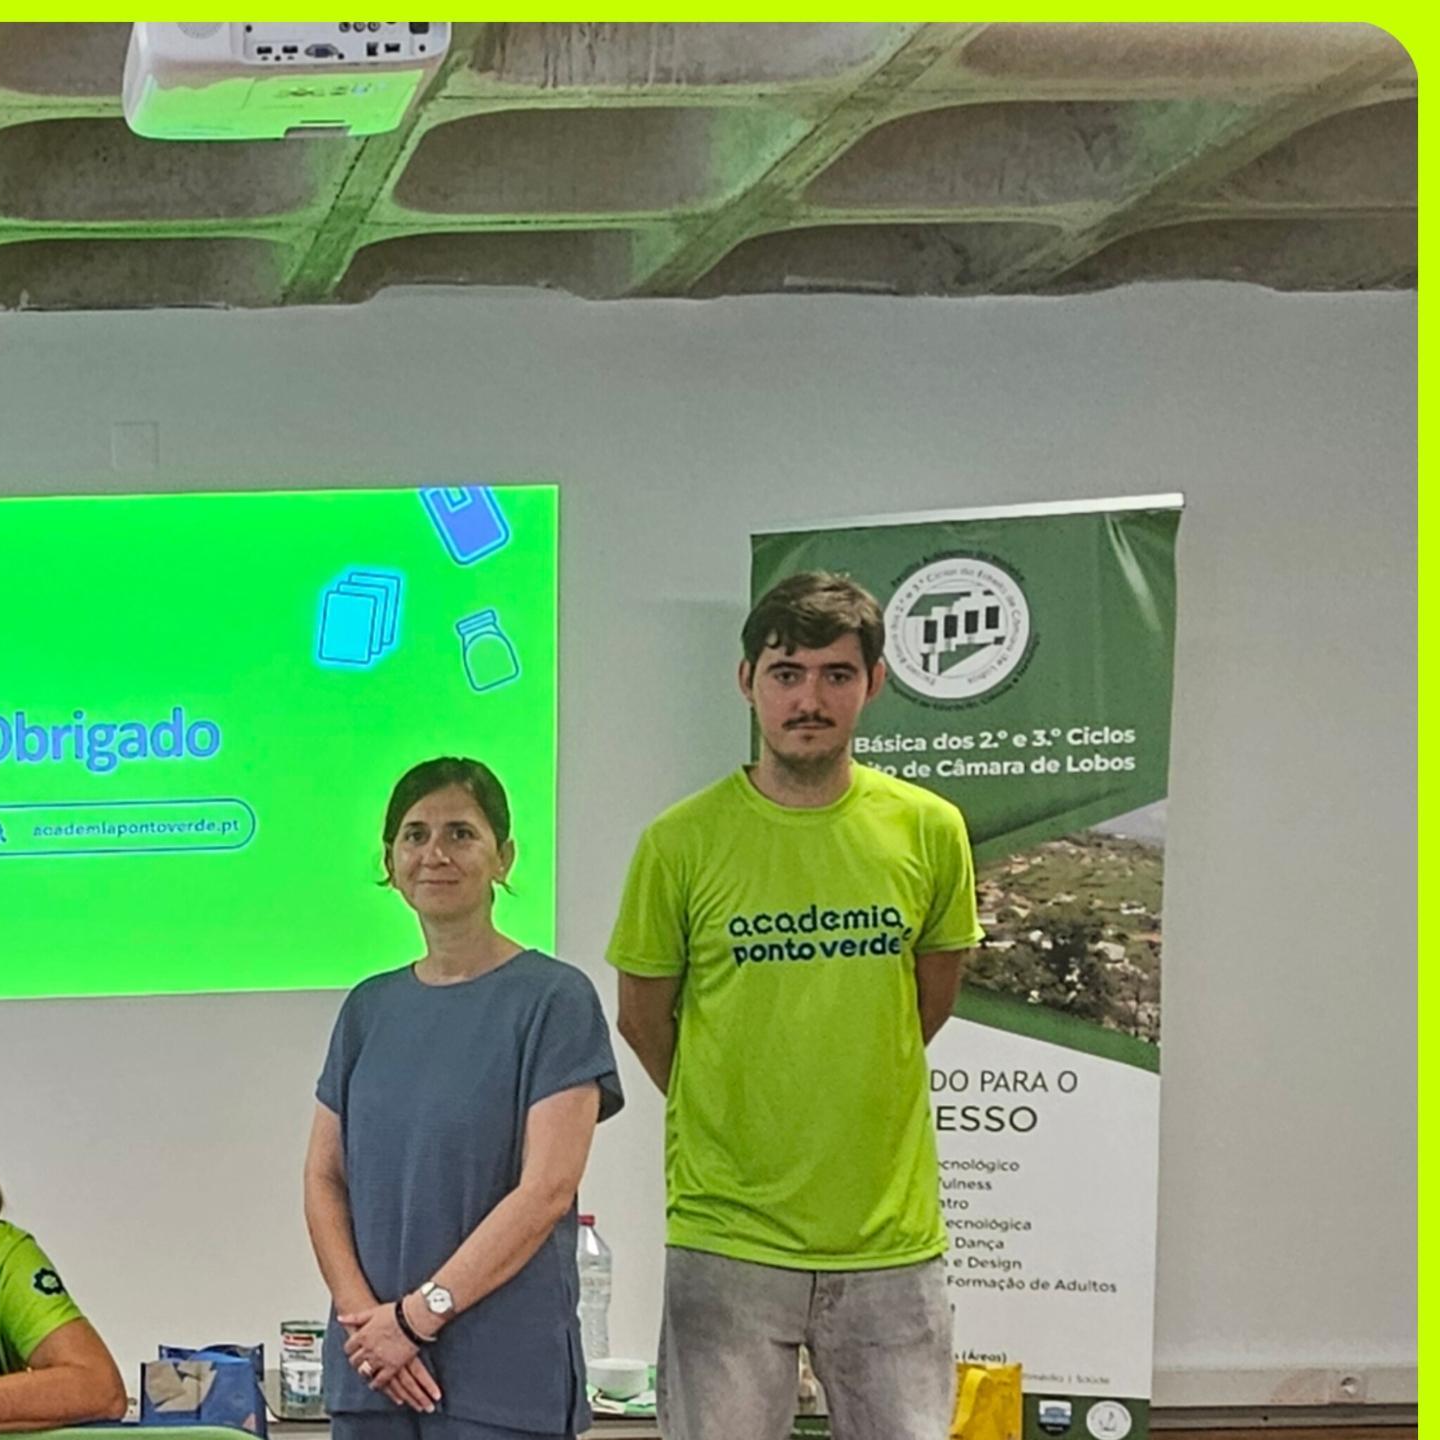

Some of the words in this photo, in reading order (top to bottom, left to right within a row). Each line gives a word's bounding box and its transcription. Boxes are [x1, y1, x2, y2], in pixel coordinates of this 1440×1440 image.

[854, 734, 927, 753] Básica
[933, 732, 975, 750] dos
[979, 730, 1008, 749] 2.º
[1012, 734, 1028, 748] e
[1032, 728, 1061, 747] 3.º
[1066, 726, 1136, 745] Ciclos
[902, 760, 931, 778] de
[936, 758, 1025, 776] Câmara
[1030, 756, 1060, 774] de
[1066, 754, 1135, 772] Lobos
[33, 818, 240, 839] academiapontoverde.pt
[728, 904, 904, 937] academia
[732, 938, 816, 967] ponto
[819, 932, 902, 958] verde
[930, 1069, 969, 1092] DO
[980, 1070, 1049, 1093] PARA
[1057, 1070, 1078, 1094] O
[936, 1105, 1038, 1132] ESSO
[939, 1158, 1020, 1174] cnológico
[939, 1177, 992, 1190] ulness
[945, 1217, 1032, 1233] ecnológica
[955, 1237, 1004, 1251] Dança
[953, 1259, 962, 1267] e
[967, 1256, 1022, 1272] Design
[946, 1275, 1026, 1291] Formação
[1029, 1278, 1051, 1291] de
[1054, 1279, 1118, 1293] Adultos
